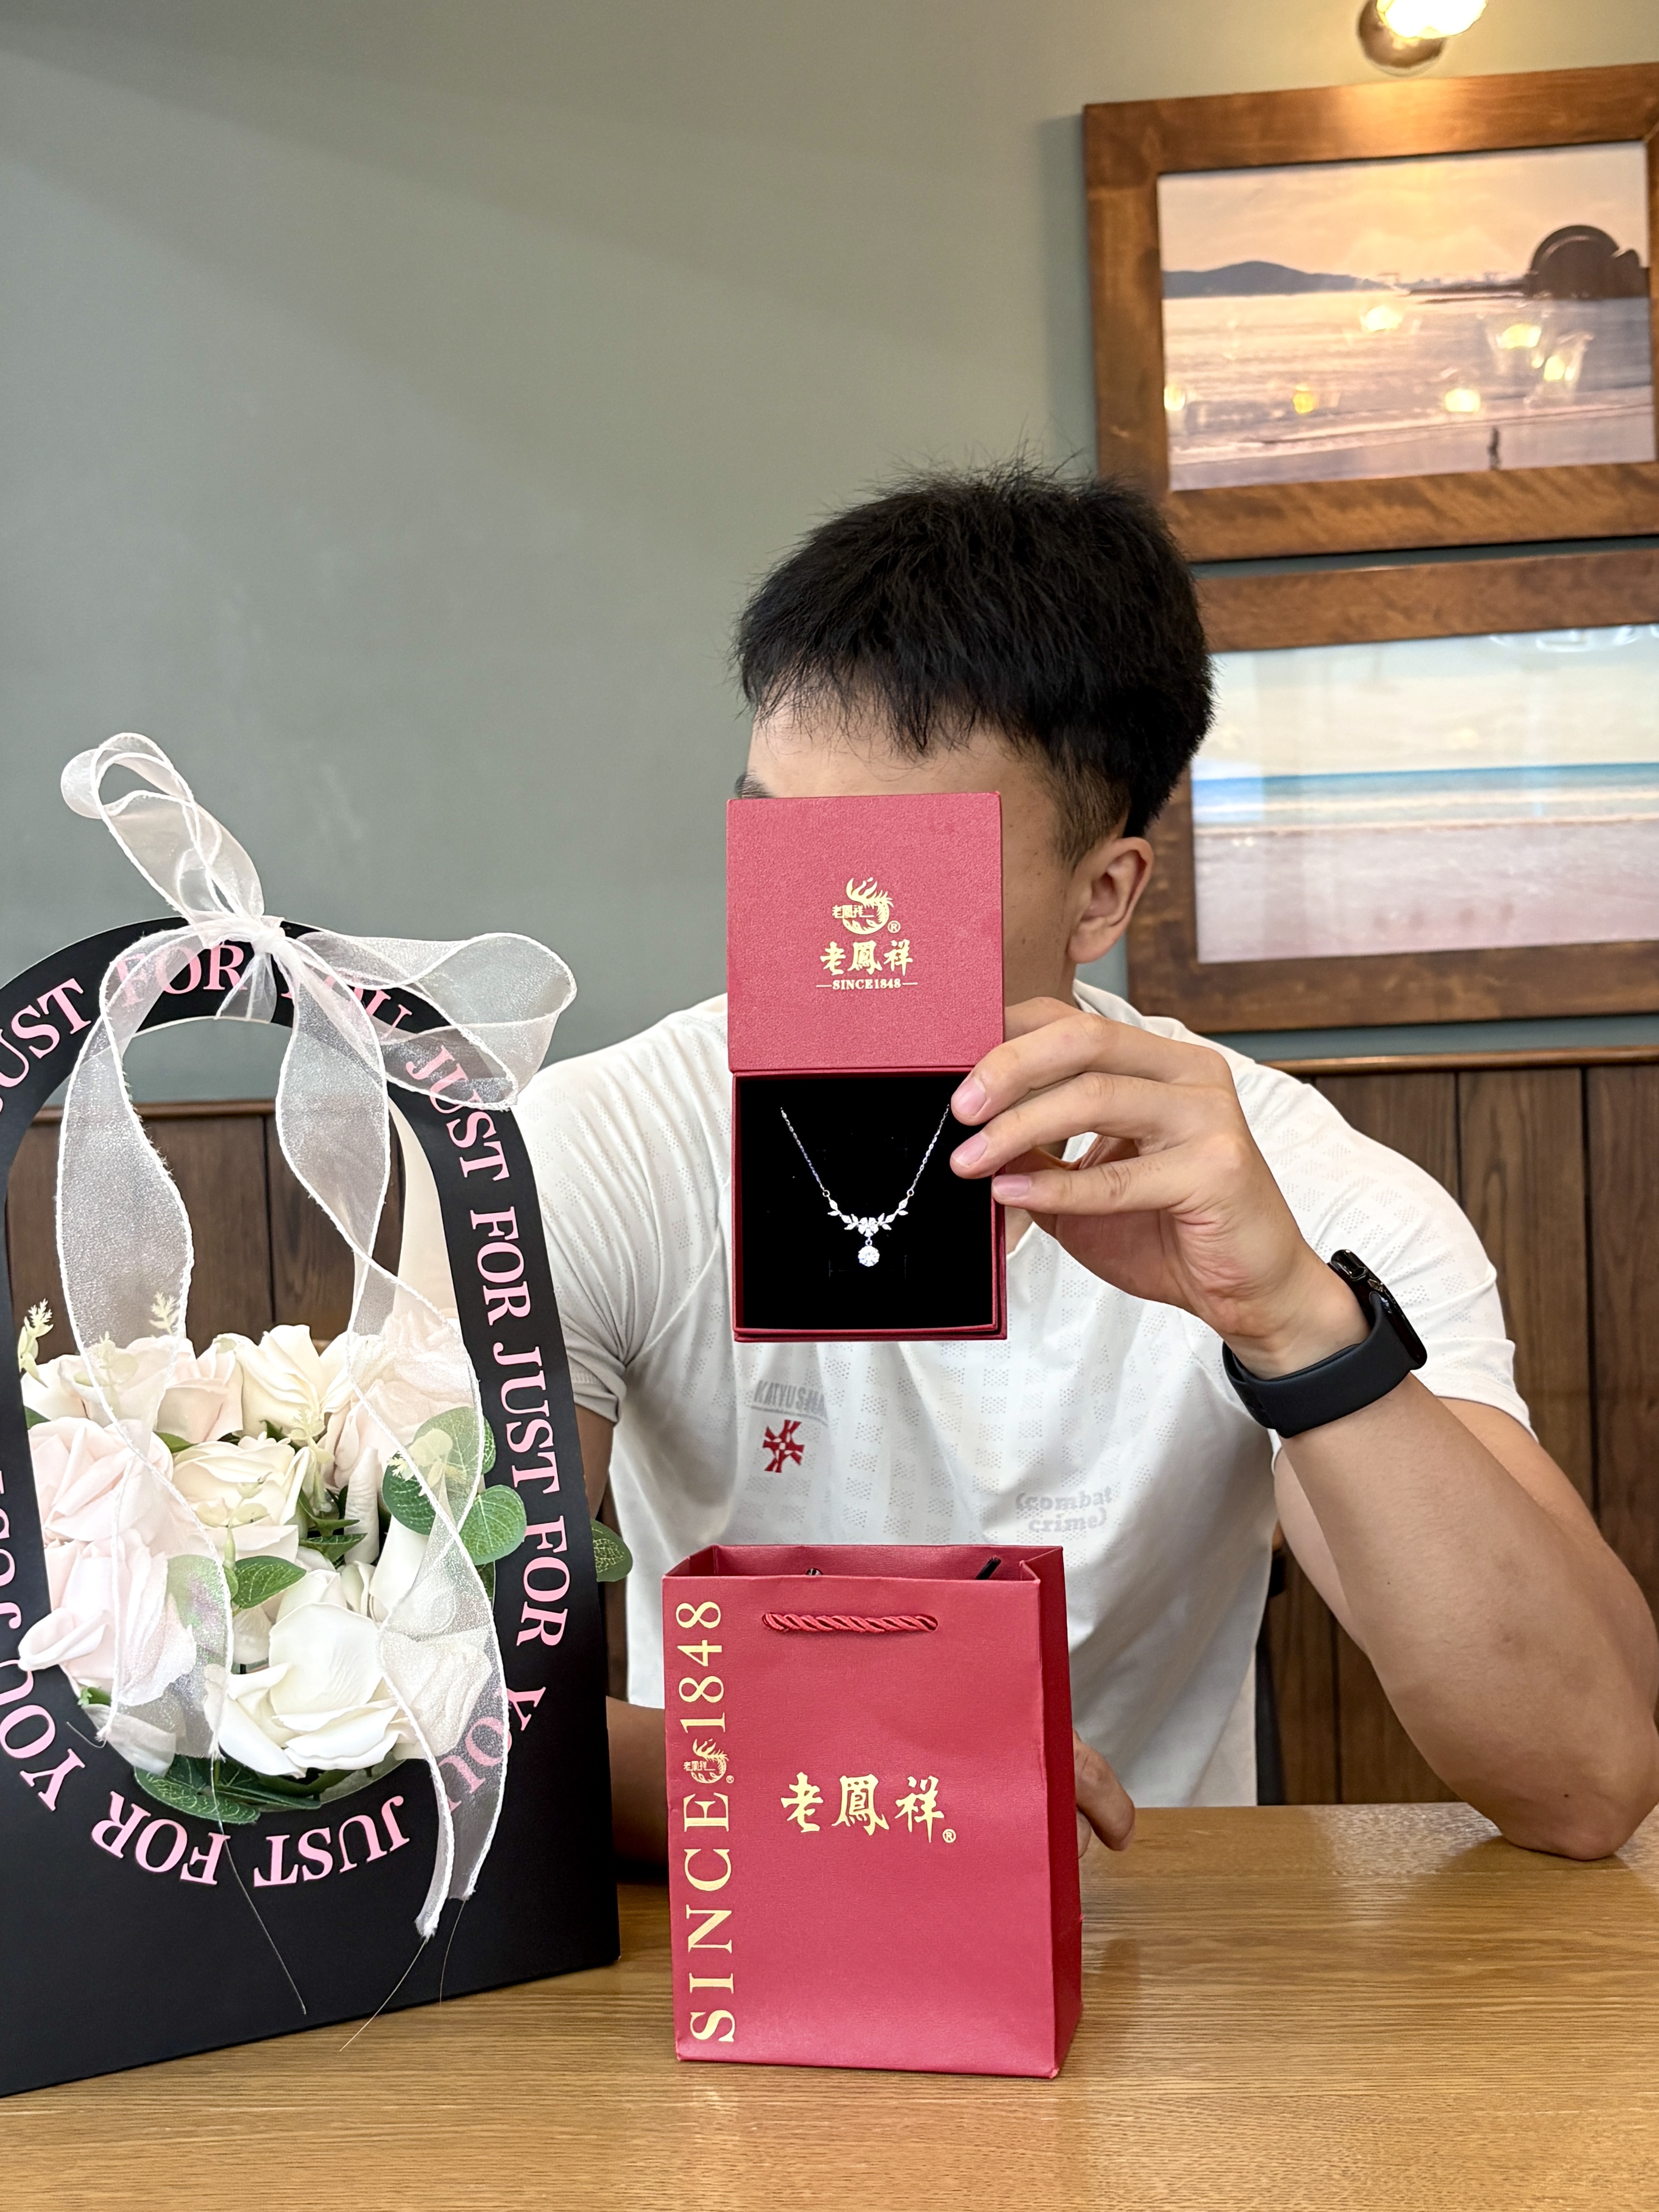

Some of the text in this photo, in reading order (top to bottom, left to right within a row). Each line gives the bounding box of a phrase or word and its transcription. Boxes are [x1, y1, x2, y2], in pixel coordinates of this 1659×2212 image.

[820, 939, 913, 976] 老鳳祥
[832, 978, 901, 990] SINCE1848
[0, 978, 91, 1115] UST
[406, 1045, 510, 1181] JUST
[470, 1206, 531, 1326] FOR
[493, 1342, 560, 1494] JUST
[515, 1515, 570, 1646] FOR
[91, 1790, 231, 1886] FOR
[253, 1795, 410, 1887] JUST
[676, 1601, 736, 2043] SINCE 1848
[780, 1771, 945, 1843] 老鳳祥
